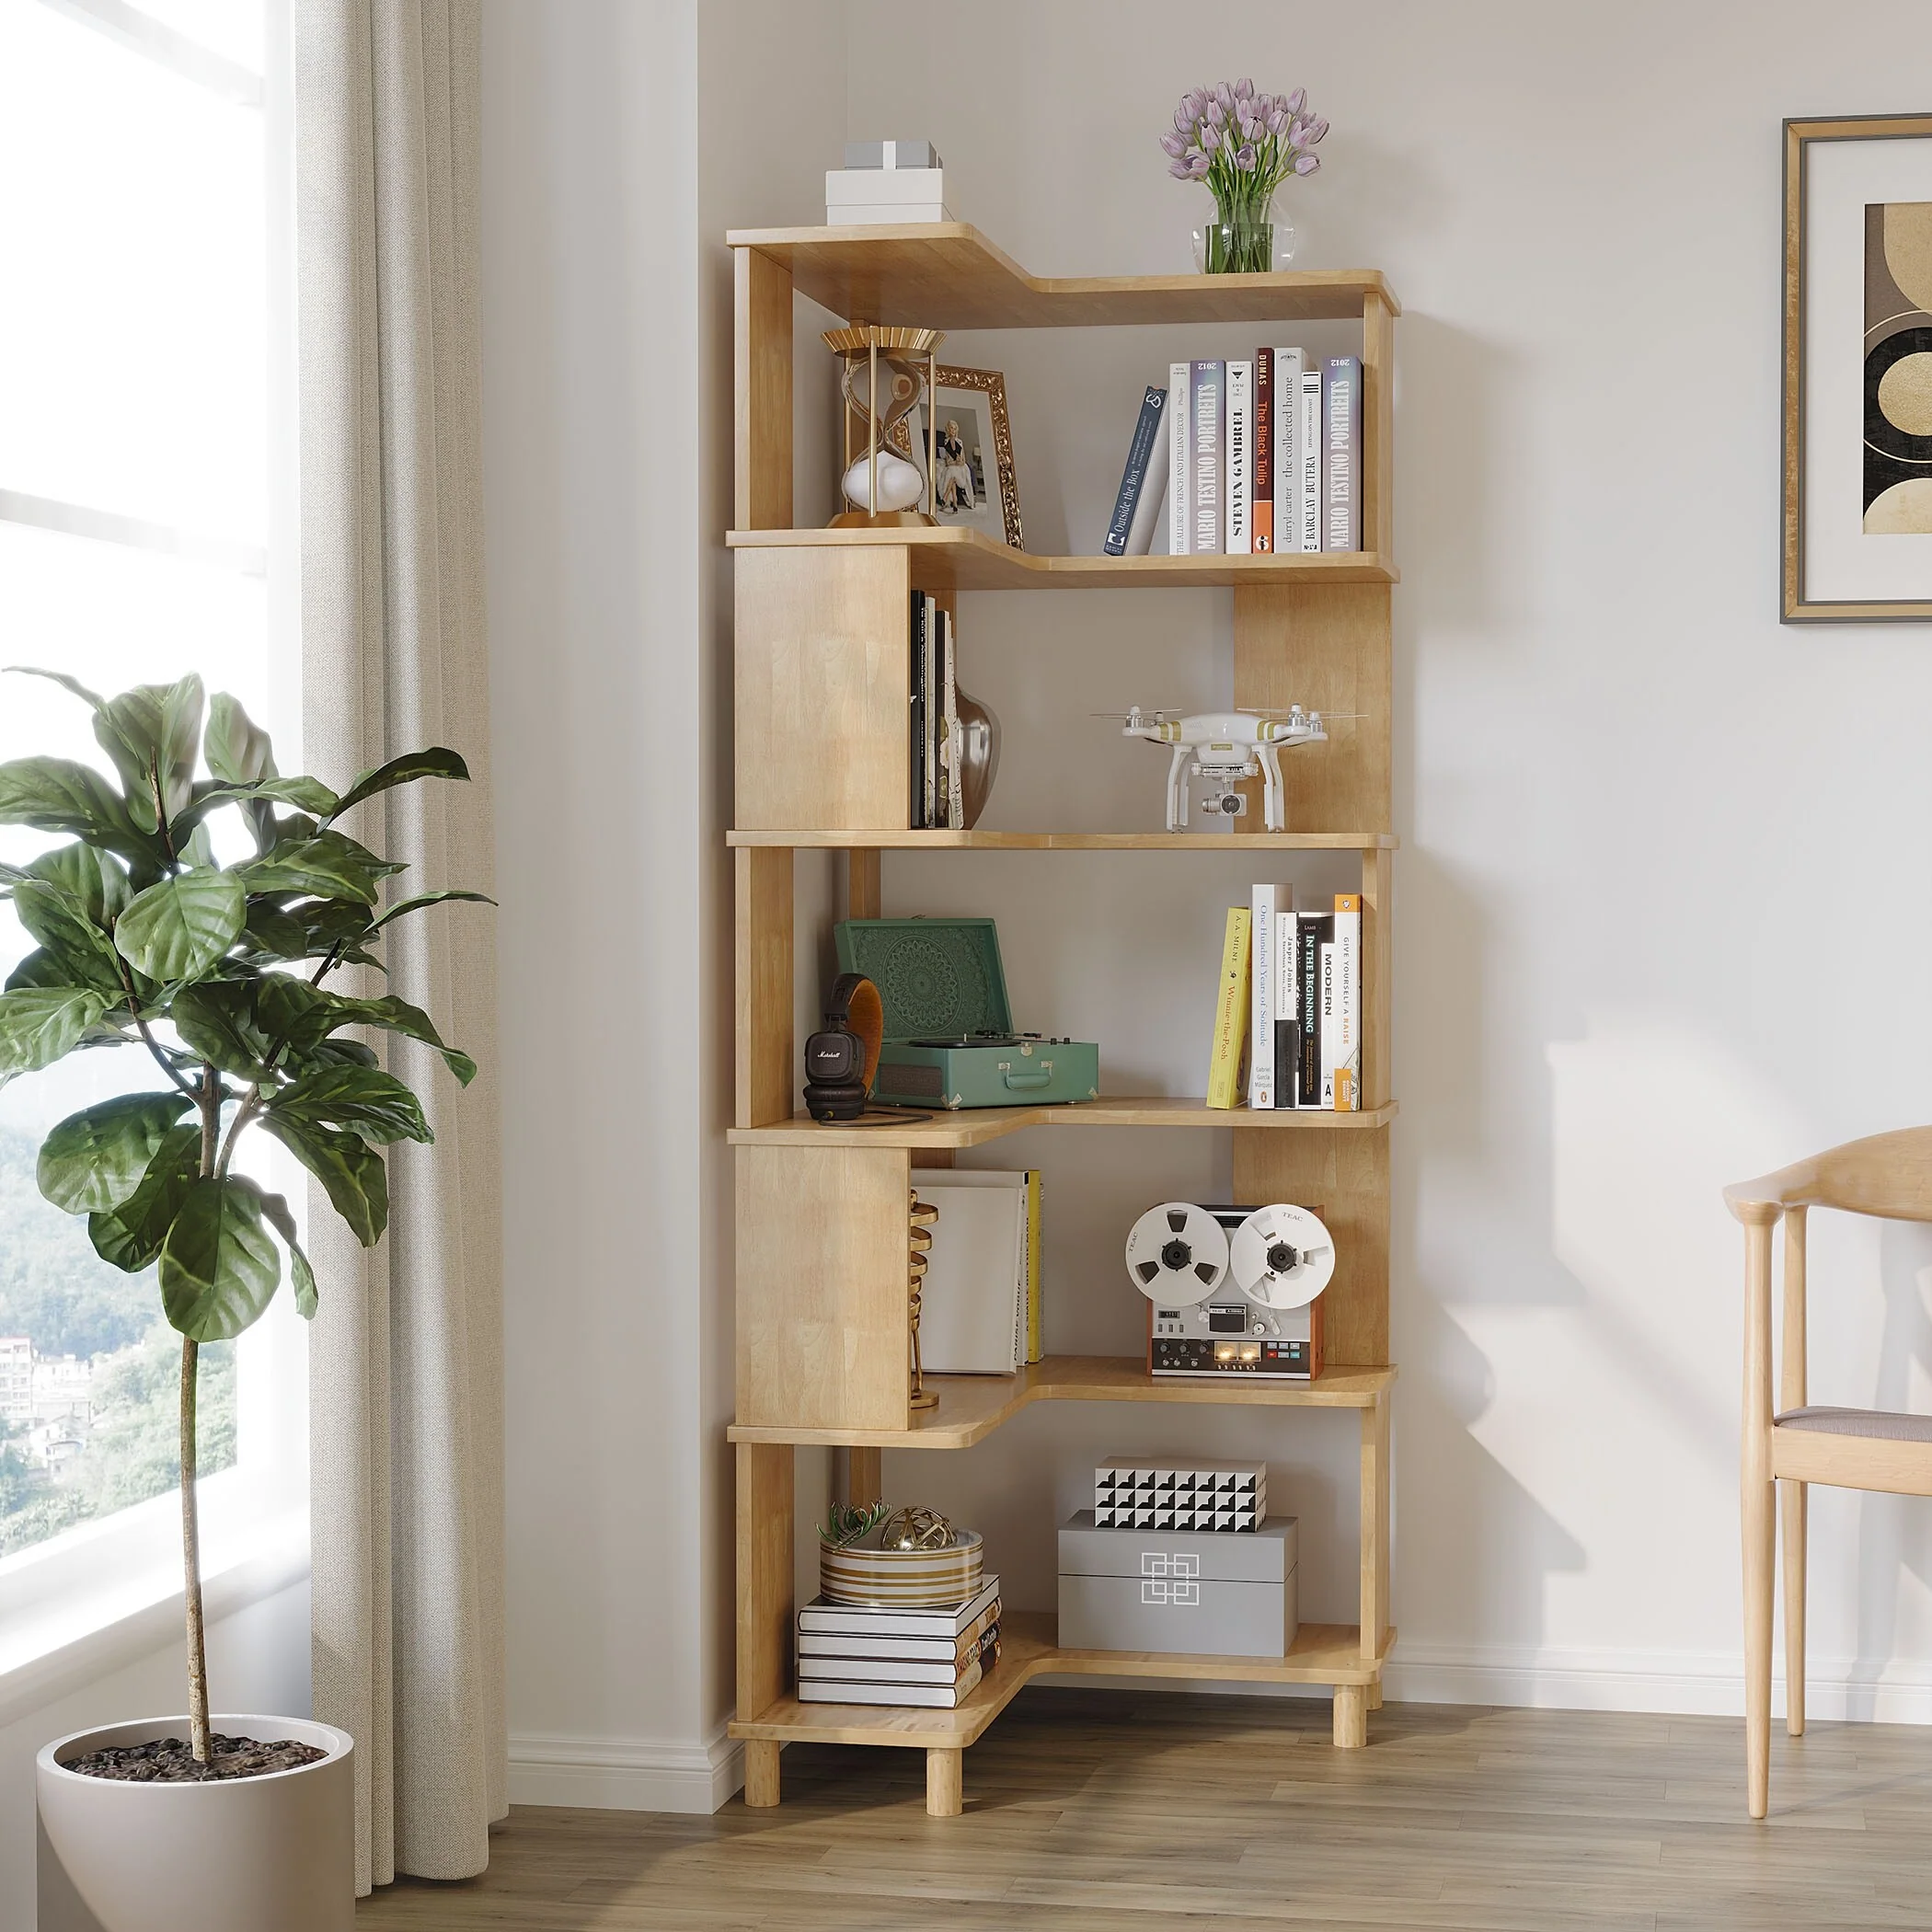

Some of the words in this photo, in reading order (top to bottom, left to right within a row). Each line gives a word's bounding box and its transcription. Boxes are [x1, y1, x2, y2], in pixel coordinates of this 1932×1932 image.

[1259, 354, 1267, 385] DUMAS
[1282, 377, 1293, 408] home
[1258, 401, 1268, 417] The
[1233, 408, 1243, 477] GAMBREL
[1258, 426, 1268, 455] Black
[1282, 411, 1293, 457] collected
[1126, 469, 1140, 485] Box
[1197, 457, 1216, 506] TESTINO
[1256, 459, 1268, 485] Tulip
[1282, 461, 1293, 477] the
[1305, 456, 1316, 493] BUTERA
[1330, 454, 1350, 503] TESTINO
[1122, 487, 1134, 500] the
[1233, 481, 1243, 536] STEVEN
[1284, 488, 1293, 513] carter
[1112, 501, 1132, 533] Outside
[1177, 506, 1184, 514] OF
[1305, 498, 1316, 540] BARCLAY
[1197, 510, 1216, 550] MARIO
[1282, 516, 1294, 543] darryl
[1330, 507, 1350, 547] MARIO
[1259, 927, 1268, 968] Hundred
[1305, 935, 1315, 948] IN
[1305, 949, 1314, 971] THE
[1259, 996, 1268, 1006] of
[1305, 973, 1315, 1032] BEGINNING
[1259, 1010, 1268, 1047] Solitude
[1325, 1084, 1331, 1097] A
